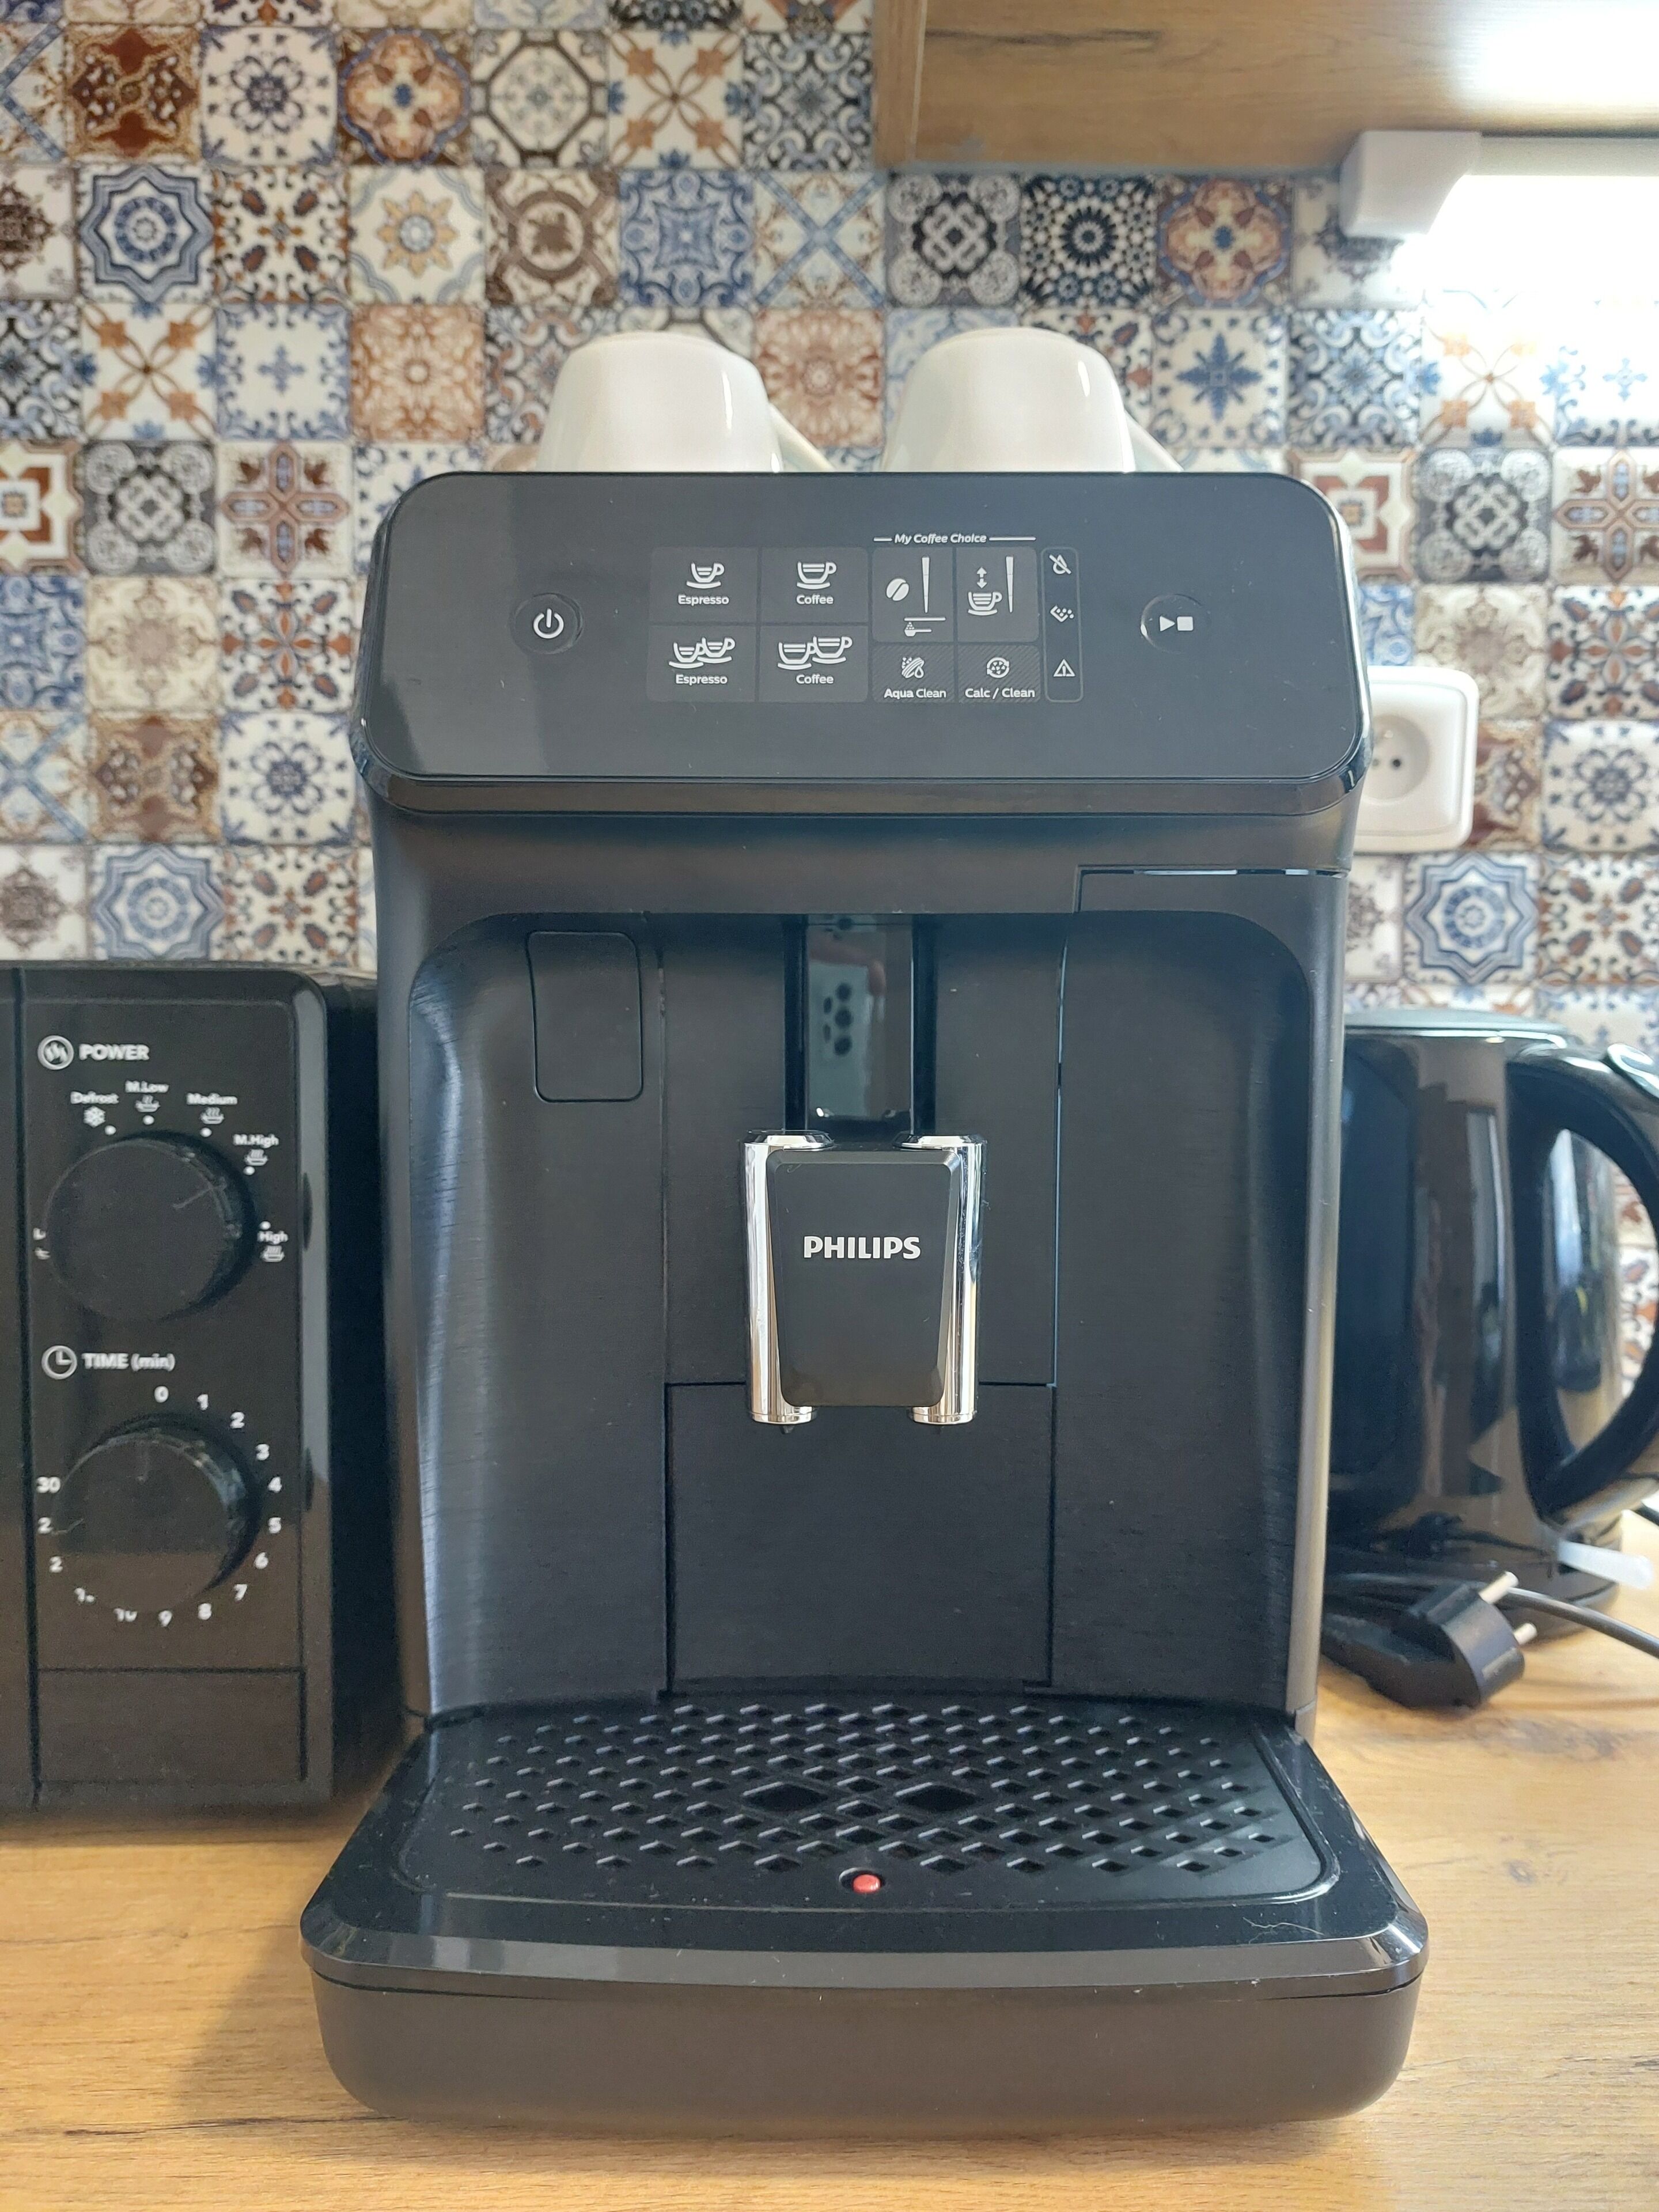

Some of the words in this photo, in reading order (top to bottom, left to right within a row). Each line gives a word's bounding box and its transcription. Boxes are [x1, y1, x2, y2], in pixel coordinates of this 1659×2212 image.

[894, 533, 911, 545] My
[913, 533, 948, 544] Coffee
[950, 533, 987, 544] Choice
[677, 594, 730, 607] Espresso
[796, 593, 834, 605] Coffee
[675, 673, 728, 686] Espresso
[796, 673, 834, 685] Coffee
[883, 688, 914, 700] Aqua
[915, 687, 947, 699] Clean
[964, 687, 991, 699] Calc
[1001, 687, 1036, 698] Clean
[78, 1043, 150, 1062] POWER
[125, 1080, 169, 1094] M.Low
[70, 1090, 120, 1105] Defrost
[186, 1093, 238, 1105] Medium
[233, 1133, 279, 1147] M.High
[257, 1230, 289, 1243] High
[803, 1235, 921, 1260] PHILIPS
[82, 1352, 130, 1370] TIME
[131, 1352, 176, 1371] (min)
[154, 1385, 169, 1403] 0
[196, 1393, 209, 1411] 1
[230, 1411, 245, 1429] 2
[255, 1442, 270, 1461] 3
[36, 1476, 61, 1494] 30
[267, 1476, 283, 1493] 4
[37, 1516, 52, 1534] 2
[268, 1516, 282, 1534] 5
[49, 1555, 63, 1573] 2
[253, 1551, 270, 1570] 6
[233, 1583, 248, 1601] 7
[157, 1609, 173, 1628] 9
[198, 1602, 213, 1621] 8
